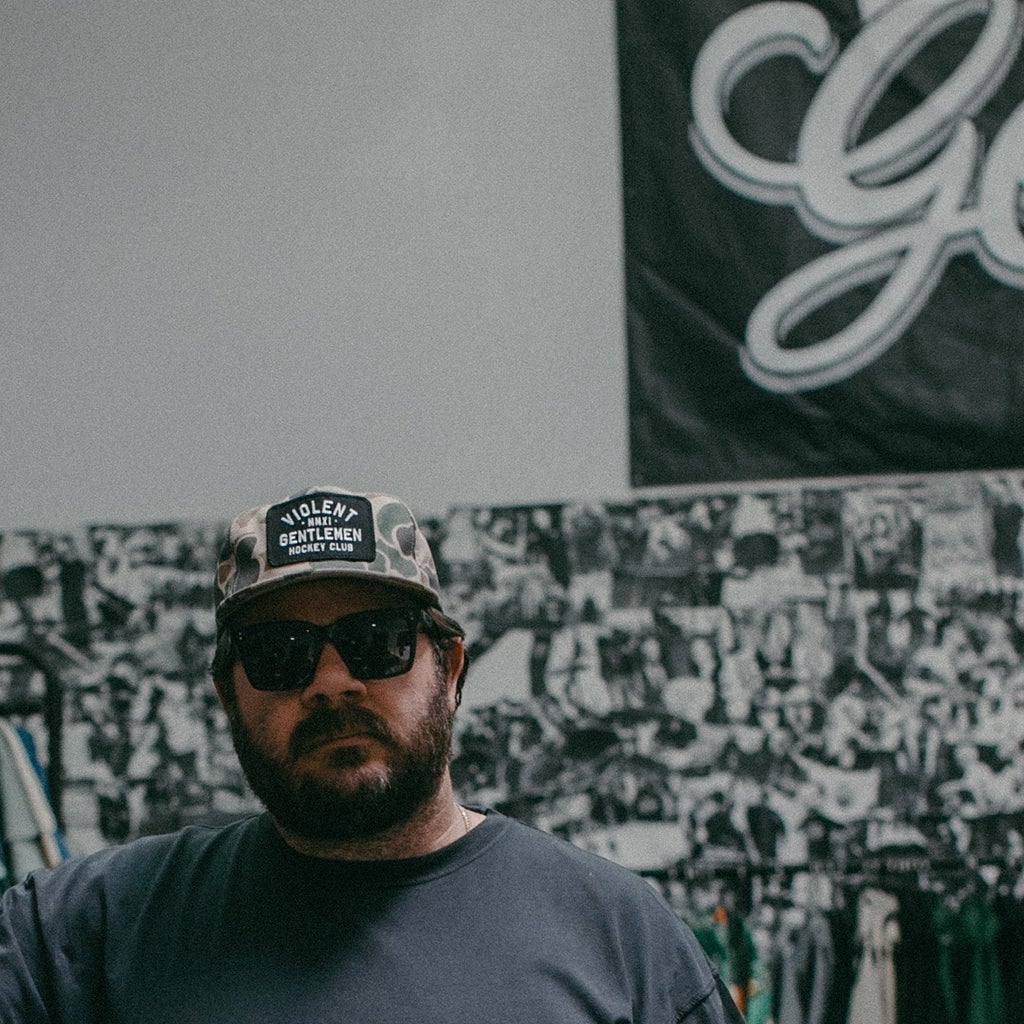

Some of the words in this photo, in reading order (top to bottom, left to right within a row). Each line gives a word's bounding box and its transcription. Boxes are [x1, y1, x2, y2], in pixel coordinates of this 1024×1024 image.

[280, 500, 358, 525] VIOLENT
[279, 528, 362, 546] GENTLEMEN
[289, 543, 326, 555] HOCKEY
[330, 542, 353, 551] CLUB
